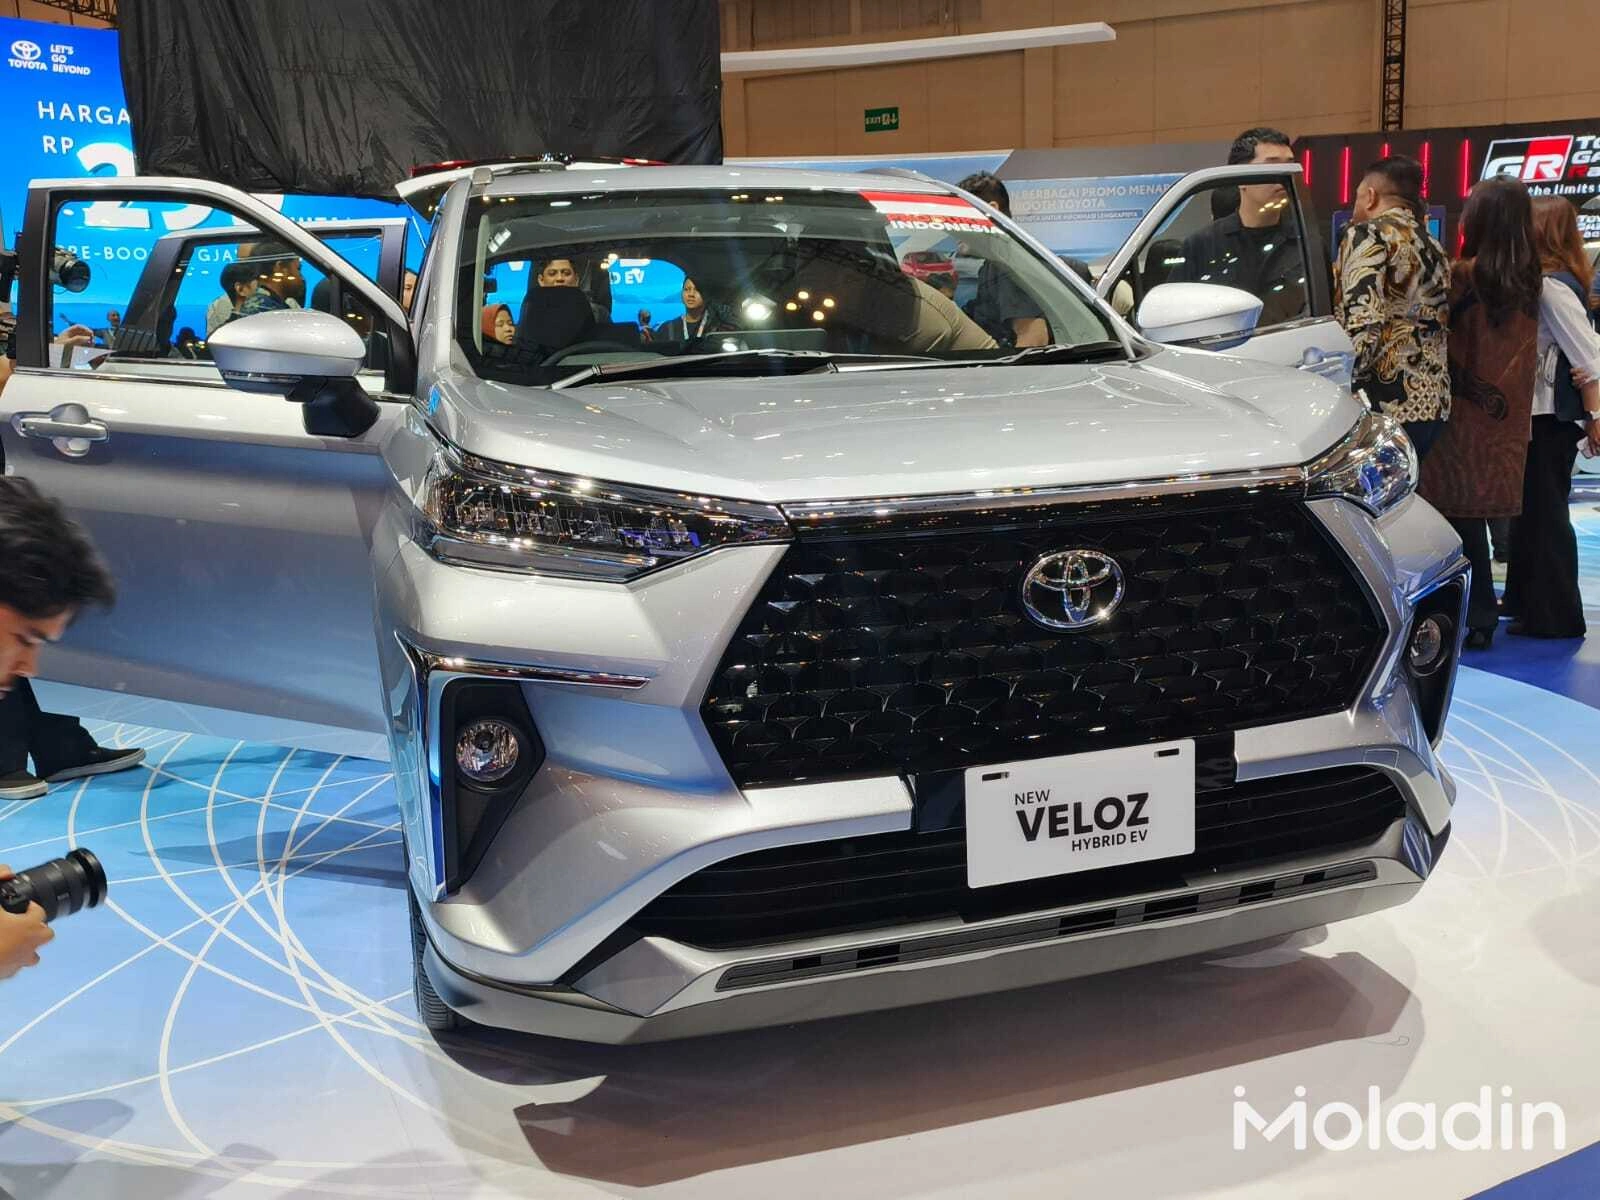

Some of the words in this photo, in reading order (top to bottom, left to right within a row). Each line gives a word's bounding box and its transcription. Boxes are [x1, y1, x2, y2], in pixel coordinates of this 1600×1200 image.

[50, 44, 74, 55] LET'S
[8, 58, 48, 71] TOYOTA
[51, 54, 67, 64] GO
[52, 64, 91, 76] BEYOND
[38, 100, 131, 125] HARGA
[42, 134, 75, 154] RP
[1485, 154, 1564, 180] GR
[1082, 185, 1126, 197] PROMO
[1553, 183, 1595, 195] limits
[1014, 789, 1050, 806] NEW
[1016, 792, 1149, 842] VELOZ
[1071, 832, 1127, 852] HYBRID
[1130, 829, 1148, 843] EV
